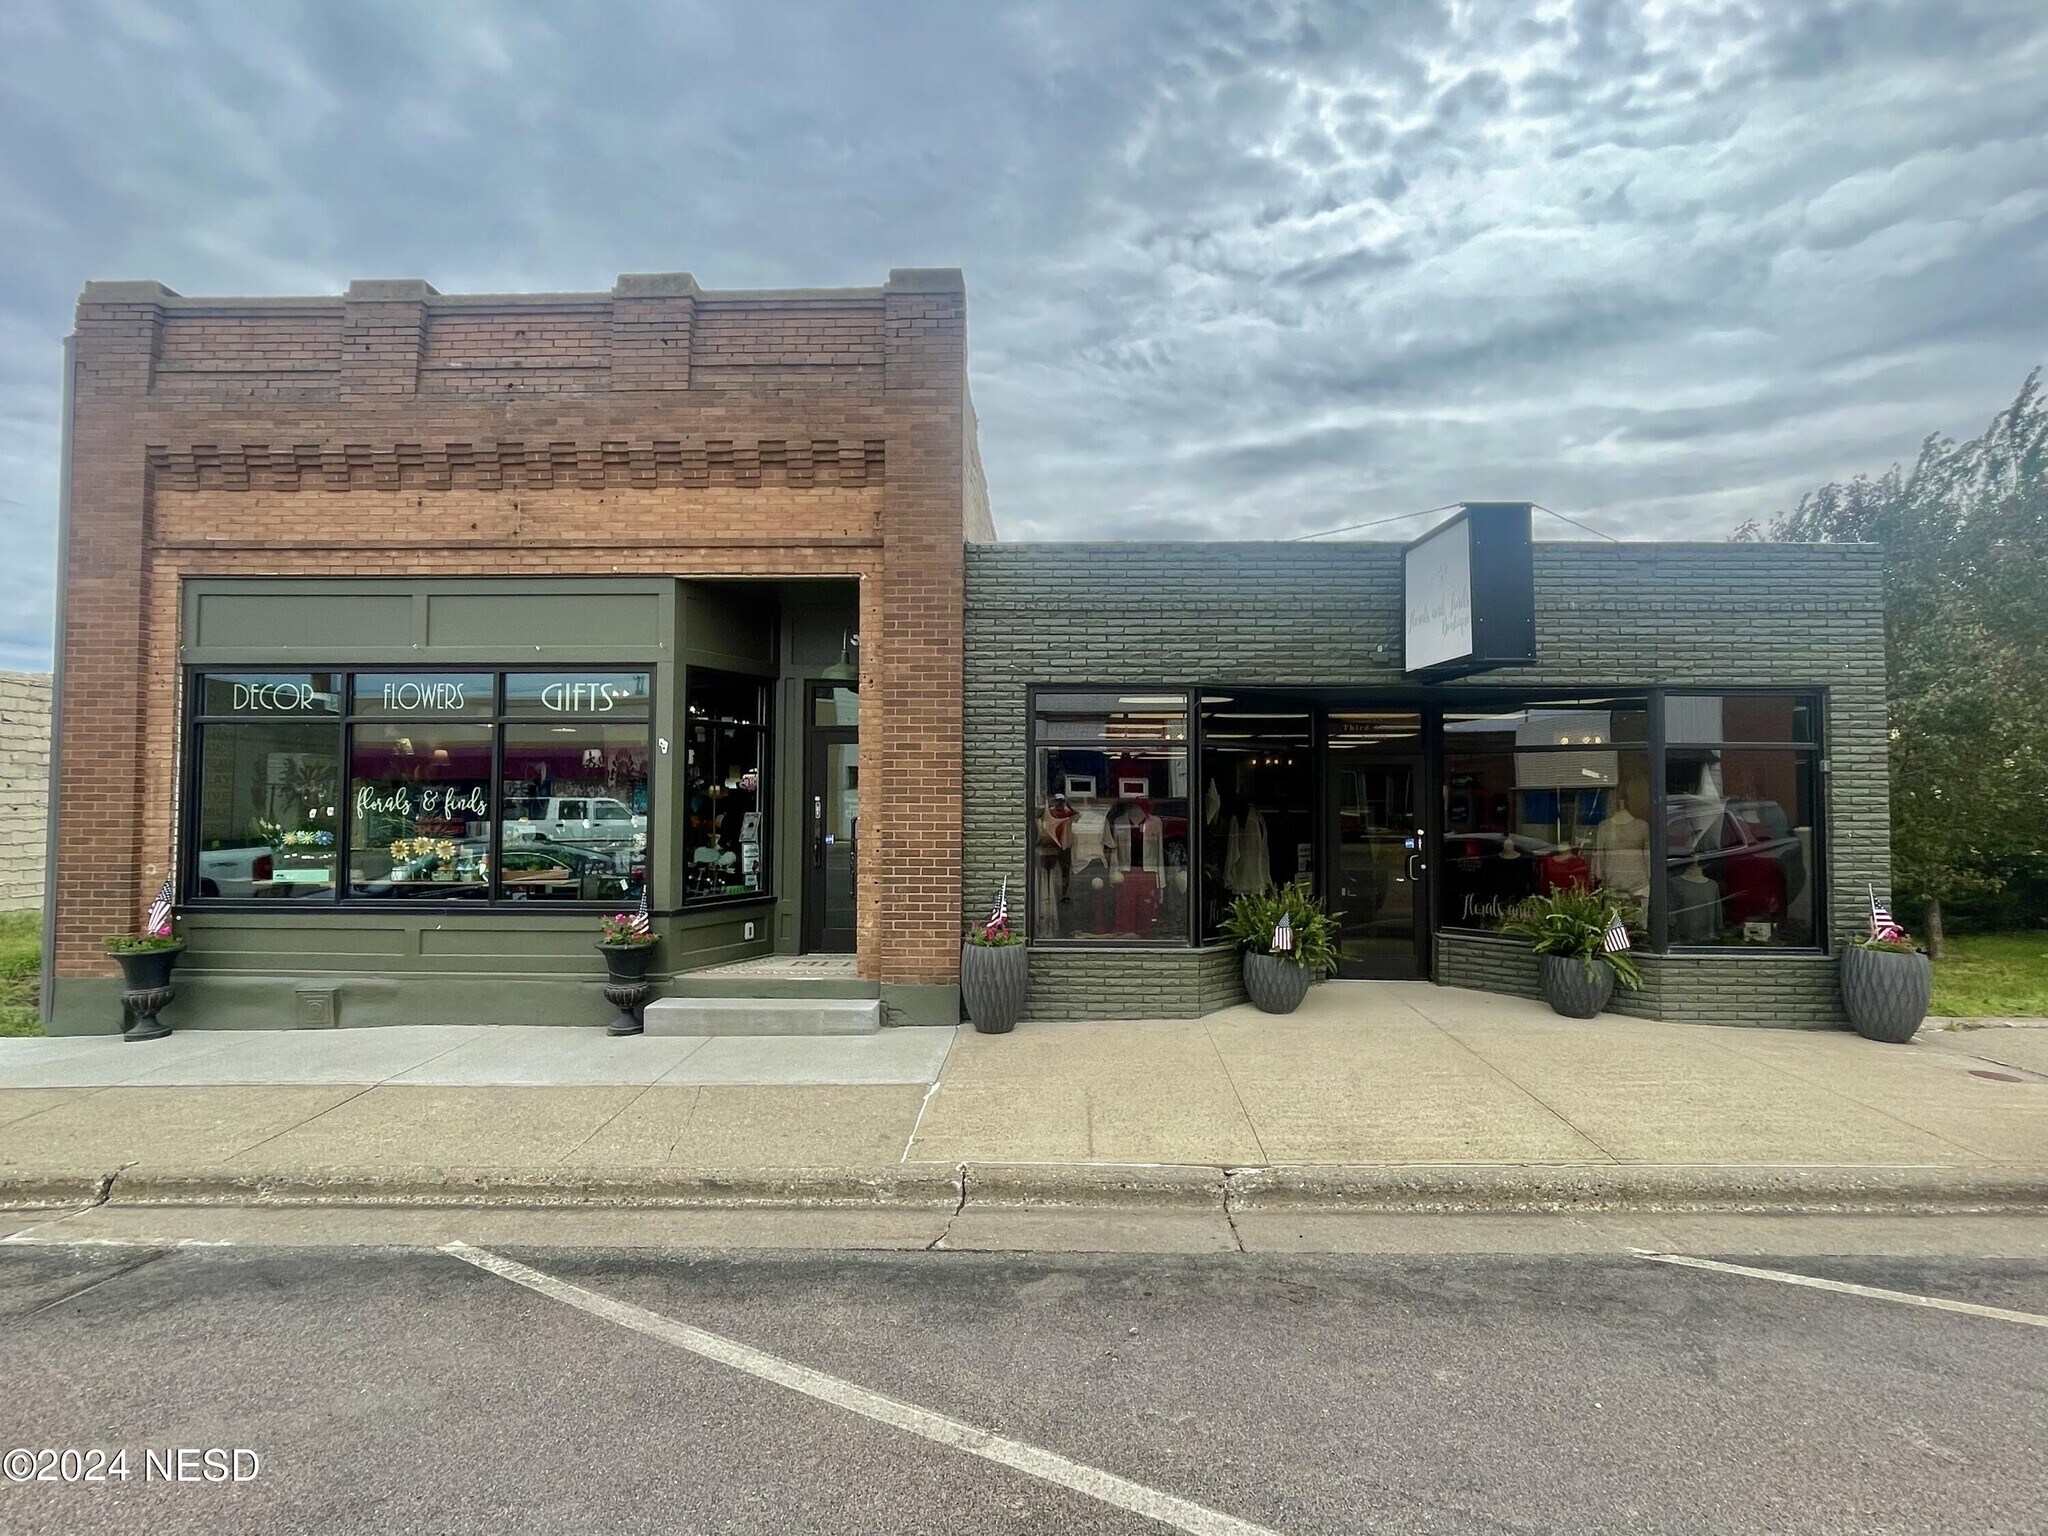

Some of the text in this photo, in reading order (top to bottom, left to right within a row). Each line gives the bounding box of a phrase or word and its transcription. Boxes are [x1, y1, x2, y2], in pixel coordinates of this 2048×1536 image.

[233, 682, 315, 711] DECOR
[384, 682, 465, 711] FLOWERS
[541, 682, 614, 713] GIFTS
[356, 786, 488, 821] florals & finds
